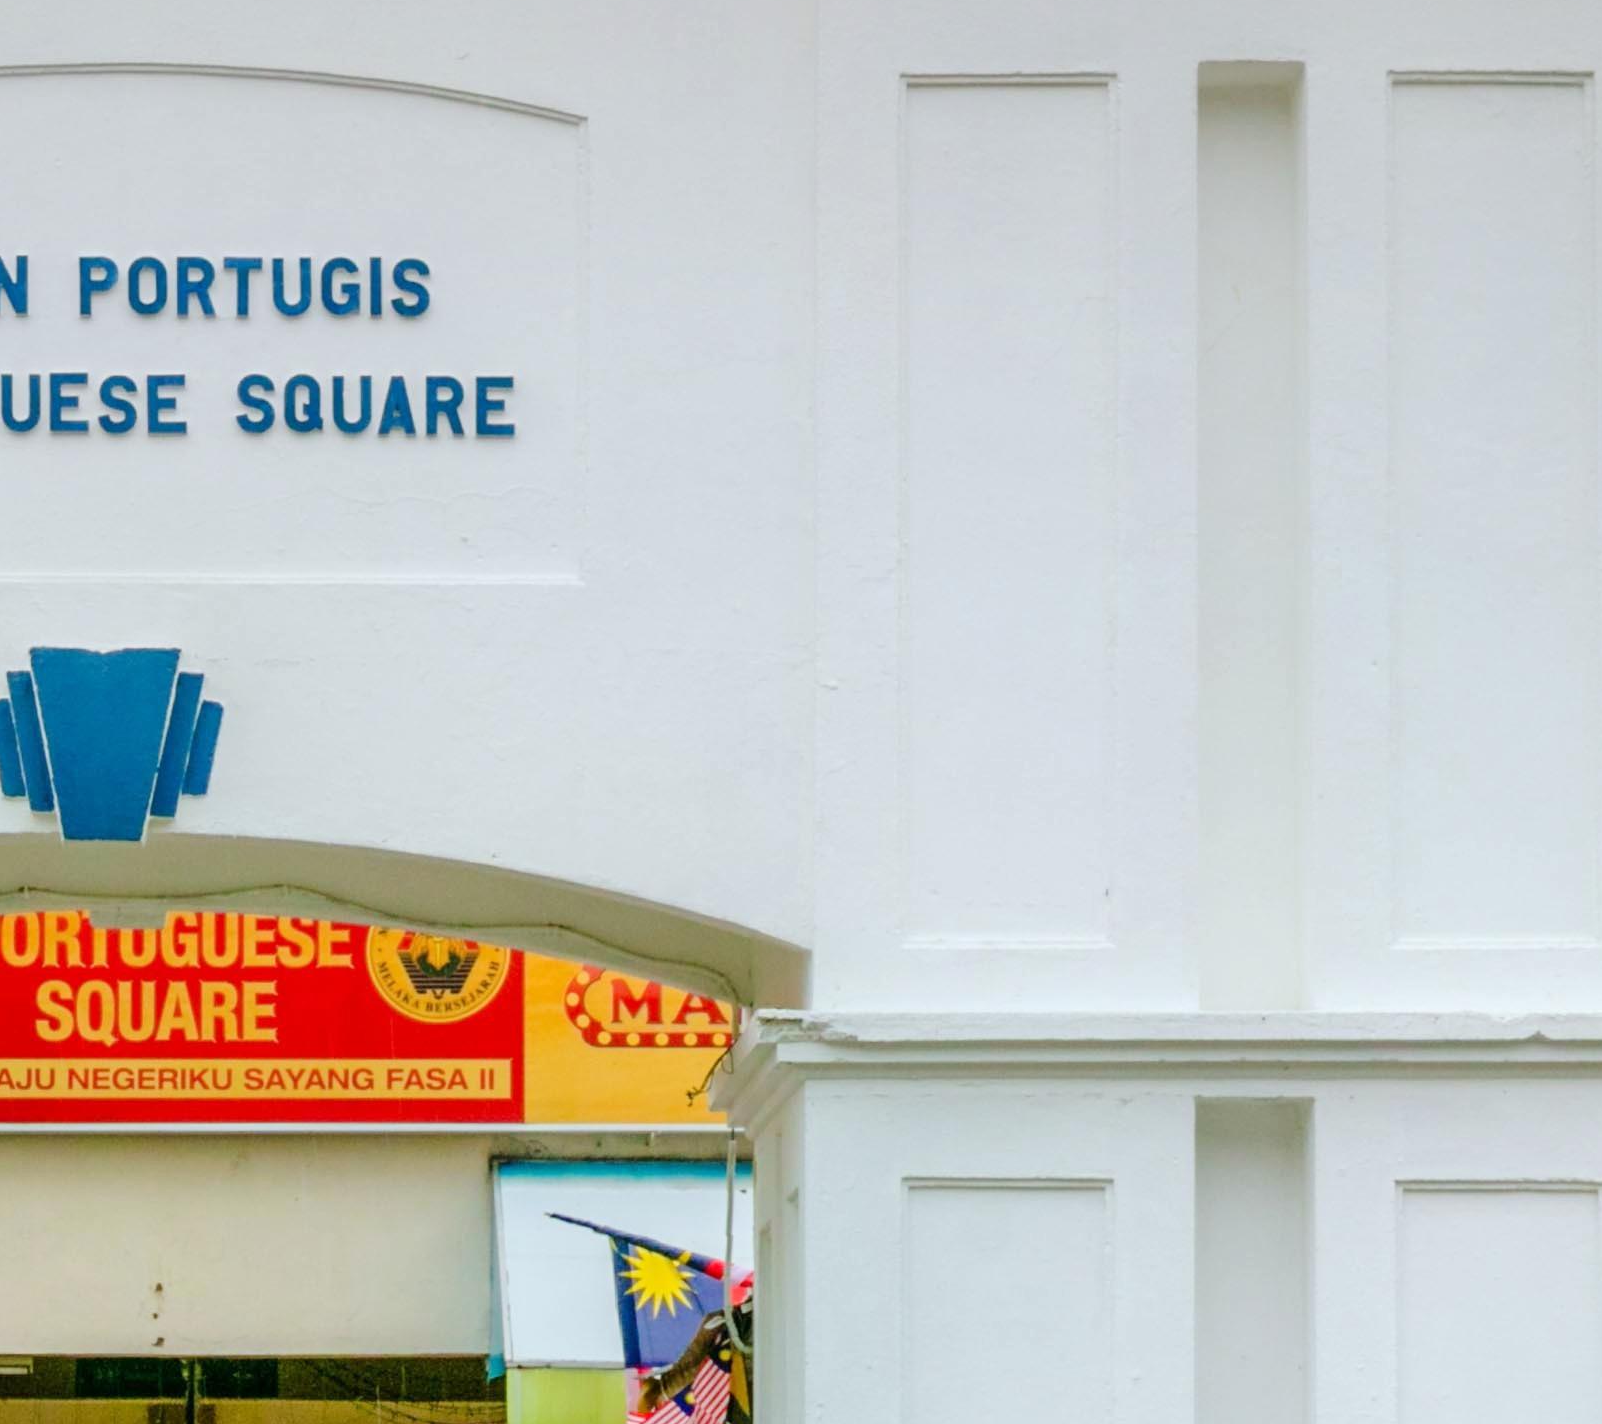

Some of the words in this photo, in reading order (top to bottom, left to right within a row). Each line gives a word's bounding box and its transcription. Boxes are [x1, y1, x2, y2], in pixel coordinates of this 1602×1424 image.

[78, 255, 432, 319] PORTUGIS
[236, 373, 516, 438] SQUARE
[35, 980, 278, 1048] SQUARE
[68, 1067, 232, 1091] NEGERIKU
[244, 1067, 375, 1091] SAYANG
[387, 1067, 469, 1091] FASA
[480, 1067, 495, 1091] II
